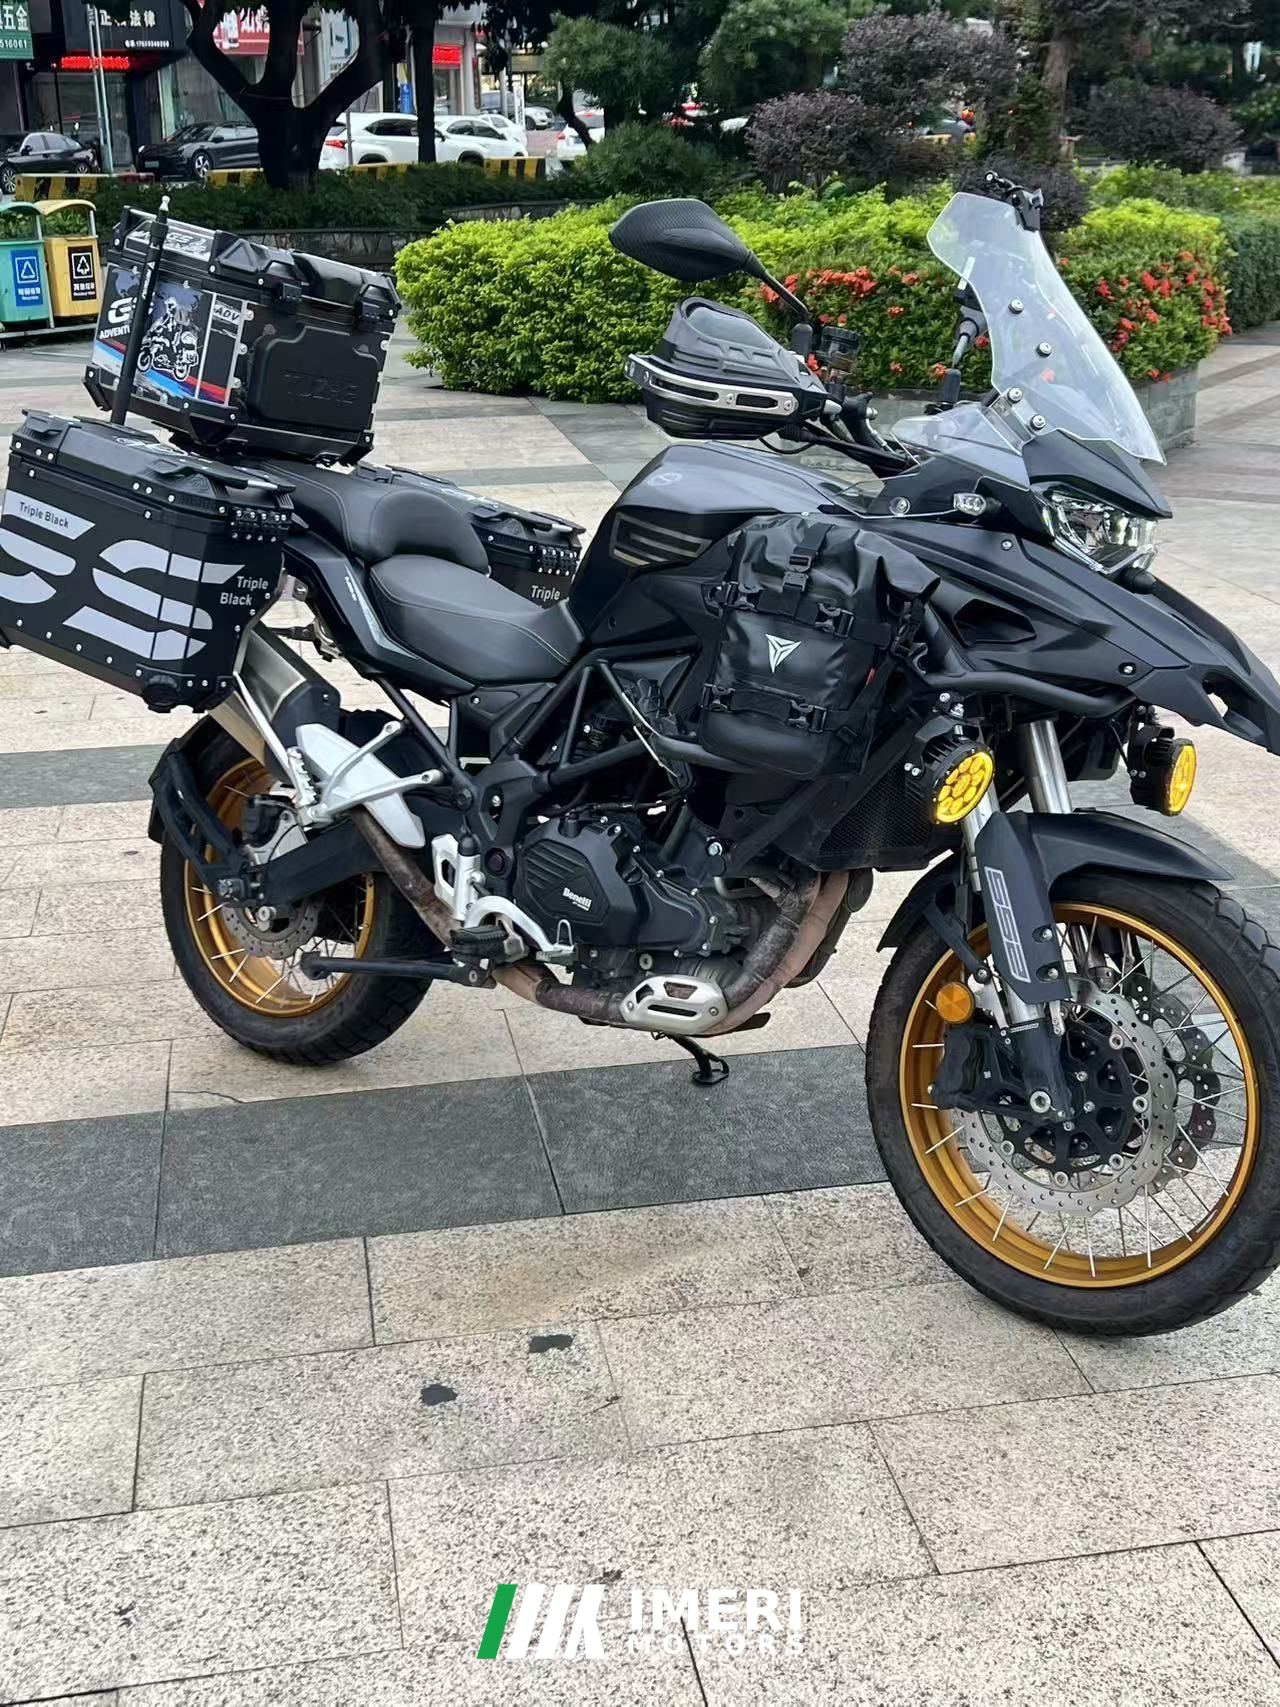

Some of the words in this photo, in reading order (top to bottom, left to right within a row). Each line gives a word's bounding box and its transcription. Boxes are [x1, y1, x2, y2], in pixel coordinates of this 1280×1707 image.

[0, 4, 28, 31] 五金
[19, 501, 46, 520] Triple
[44, 511, 70, 529] Black
[236, 575, 268, 591] Triple
[220, 592, 252, 606] Black
[531, 585, 561, 602] Triple
